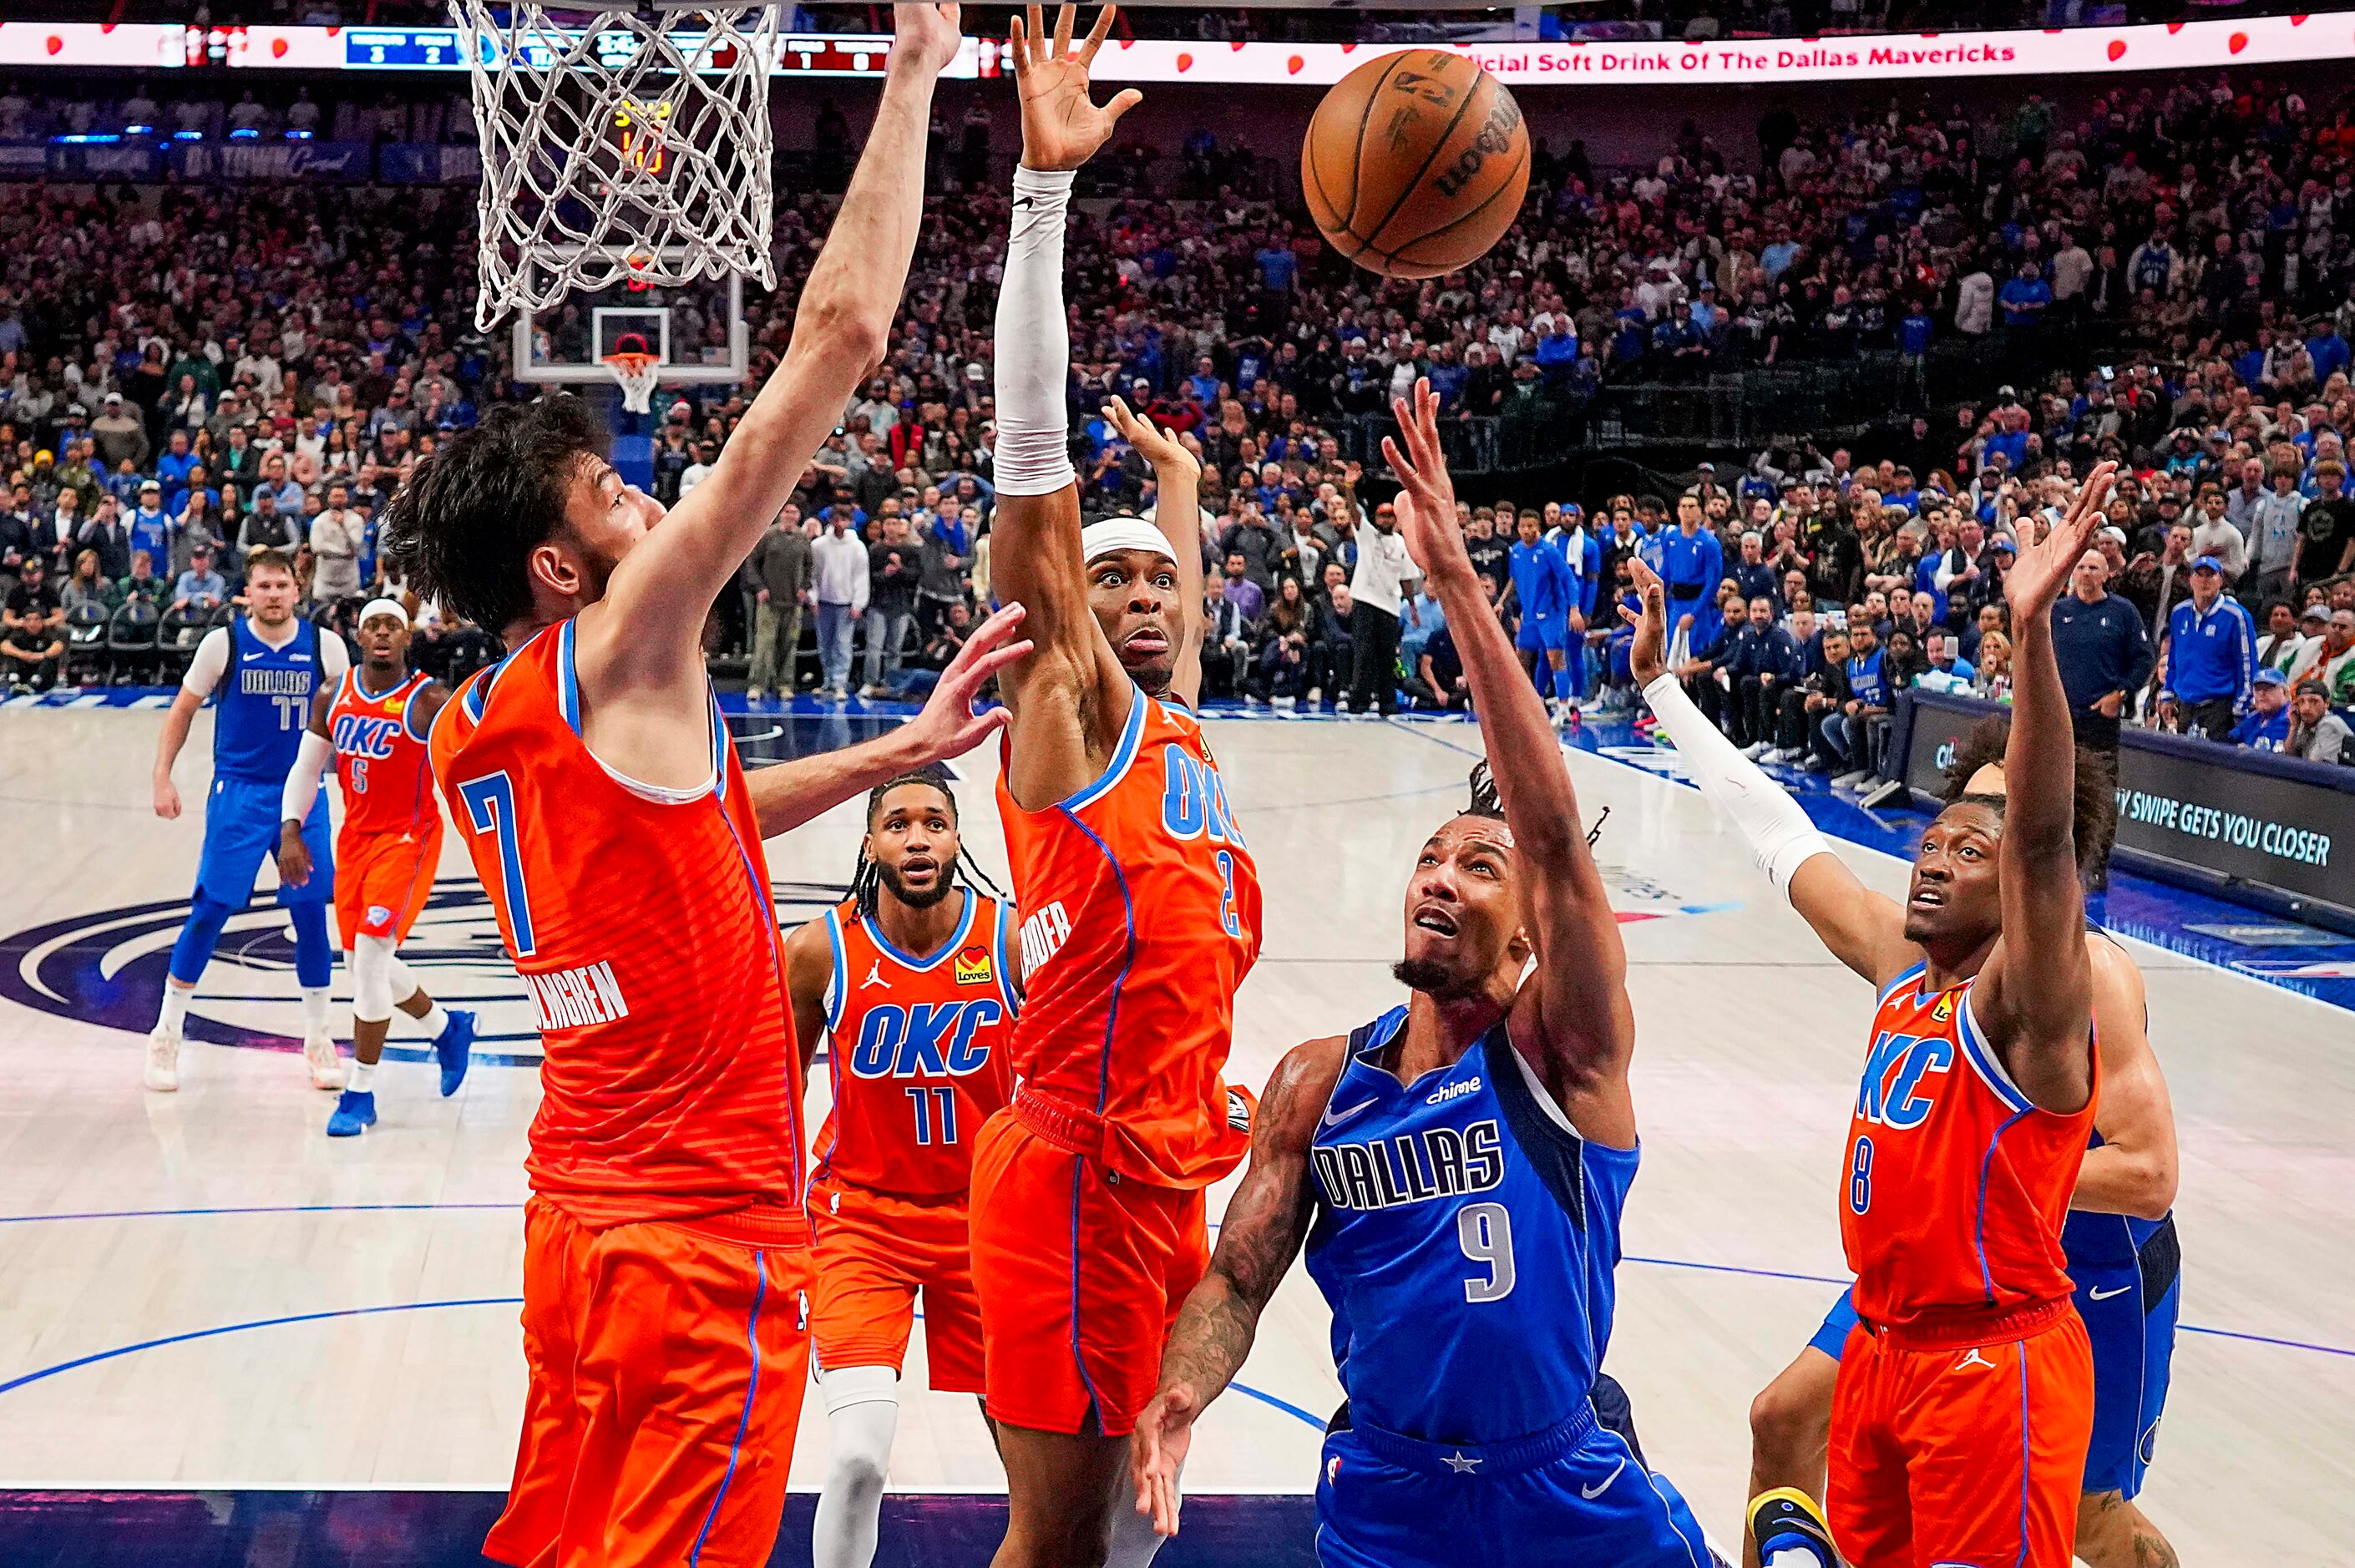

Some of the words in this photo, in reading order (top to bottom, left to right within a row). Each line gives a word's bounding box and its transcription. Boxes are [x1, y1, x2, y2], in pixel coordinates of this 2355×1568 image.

[1468, 53, 1528, 72] icial
[1538, 53, 1591, 72] Soft
[1601, 53, 1671, 71] Drink
[1679, 52, 1710, 71] Of
[1718, 52, 1769, 70] The
[1777, 49, 1859, 68] Dallas
[1868, 43, 2016, 65] Mavericks
[241, 669, 312, 695] DALLAS
[271, 695, 310, 731] 77
[335, 712, 403, 761] OKC
[351, 757, 369, 795] 5
[1162, 742, 1248, 852] OK
[2130, 791, 2180, 829] SWIPE
[2179, 802, 2221, 840] GETS
[2222, 812, 2261, 850] YOU
[2261, 822, 2331, 867] CLOSER
[457, 768, 536, 958] 7
[1217, 849, 1243, 939] 2
[1020, 900, 1072, 985] ANDER
[850, 998, 1003, 1080] OKC
[1856, 1029, 1955, 1130] KC
[905, 1087, 958, 1146] 11
[1426, 1075, 1482, 1105] chime
[1311, 1119, 1505, 1211] DALLAS
[1849, 1134, 1875, 1216] 8
[1456, 1201, 1517, 1303] 9
